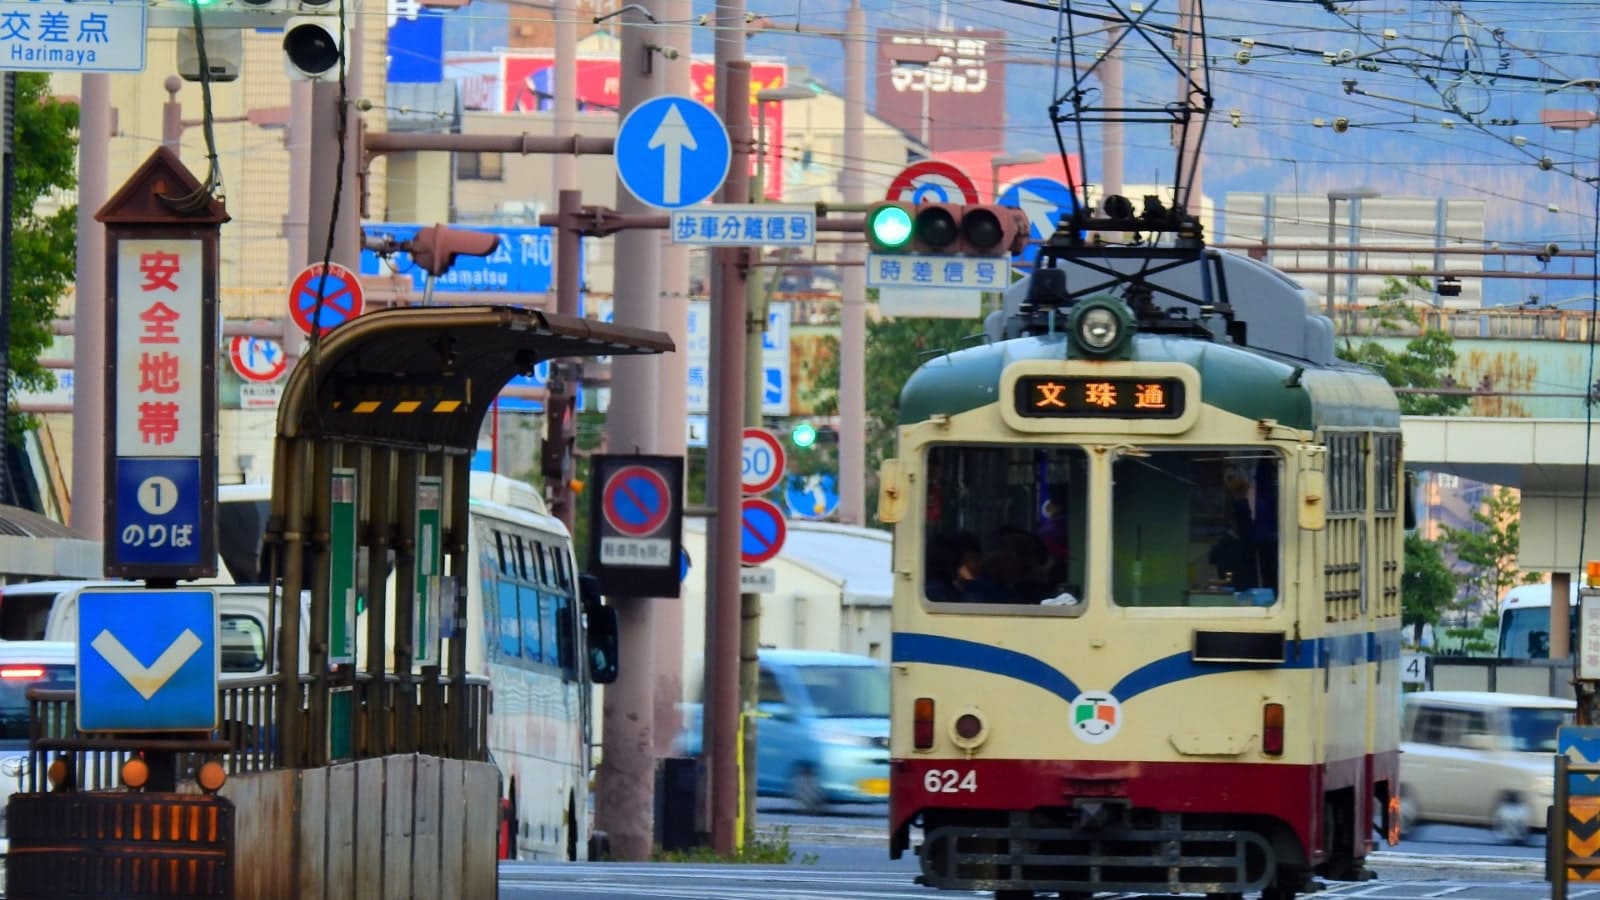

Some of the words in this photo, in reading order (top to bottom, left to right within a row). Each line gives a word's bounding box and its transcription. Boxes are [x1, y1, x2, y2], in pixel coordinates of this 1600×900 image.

[0, 10, 109, 43] 交差点
[11, 44, 97, 65] Harimaya
[891, 67, 988, 93] マンション
[677, 216, 808, 240] 歩車分離信号
[880, 260, 996, 283] 時差信号
[138, 250, 181, 446] 安全地帯
[1035, 382, 1166, 408] 文珠通
[121, 524, 193, 548] のりば
[1406, 658, 1421, 678] 4
[923, 769, 978, 793] 624
